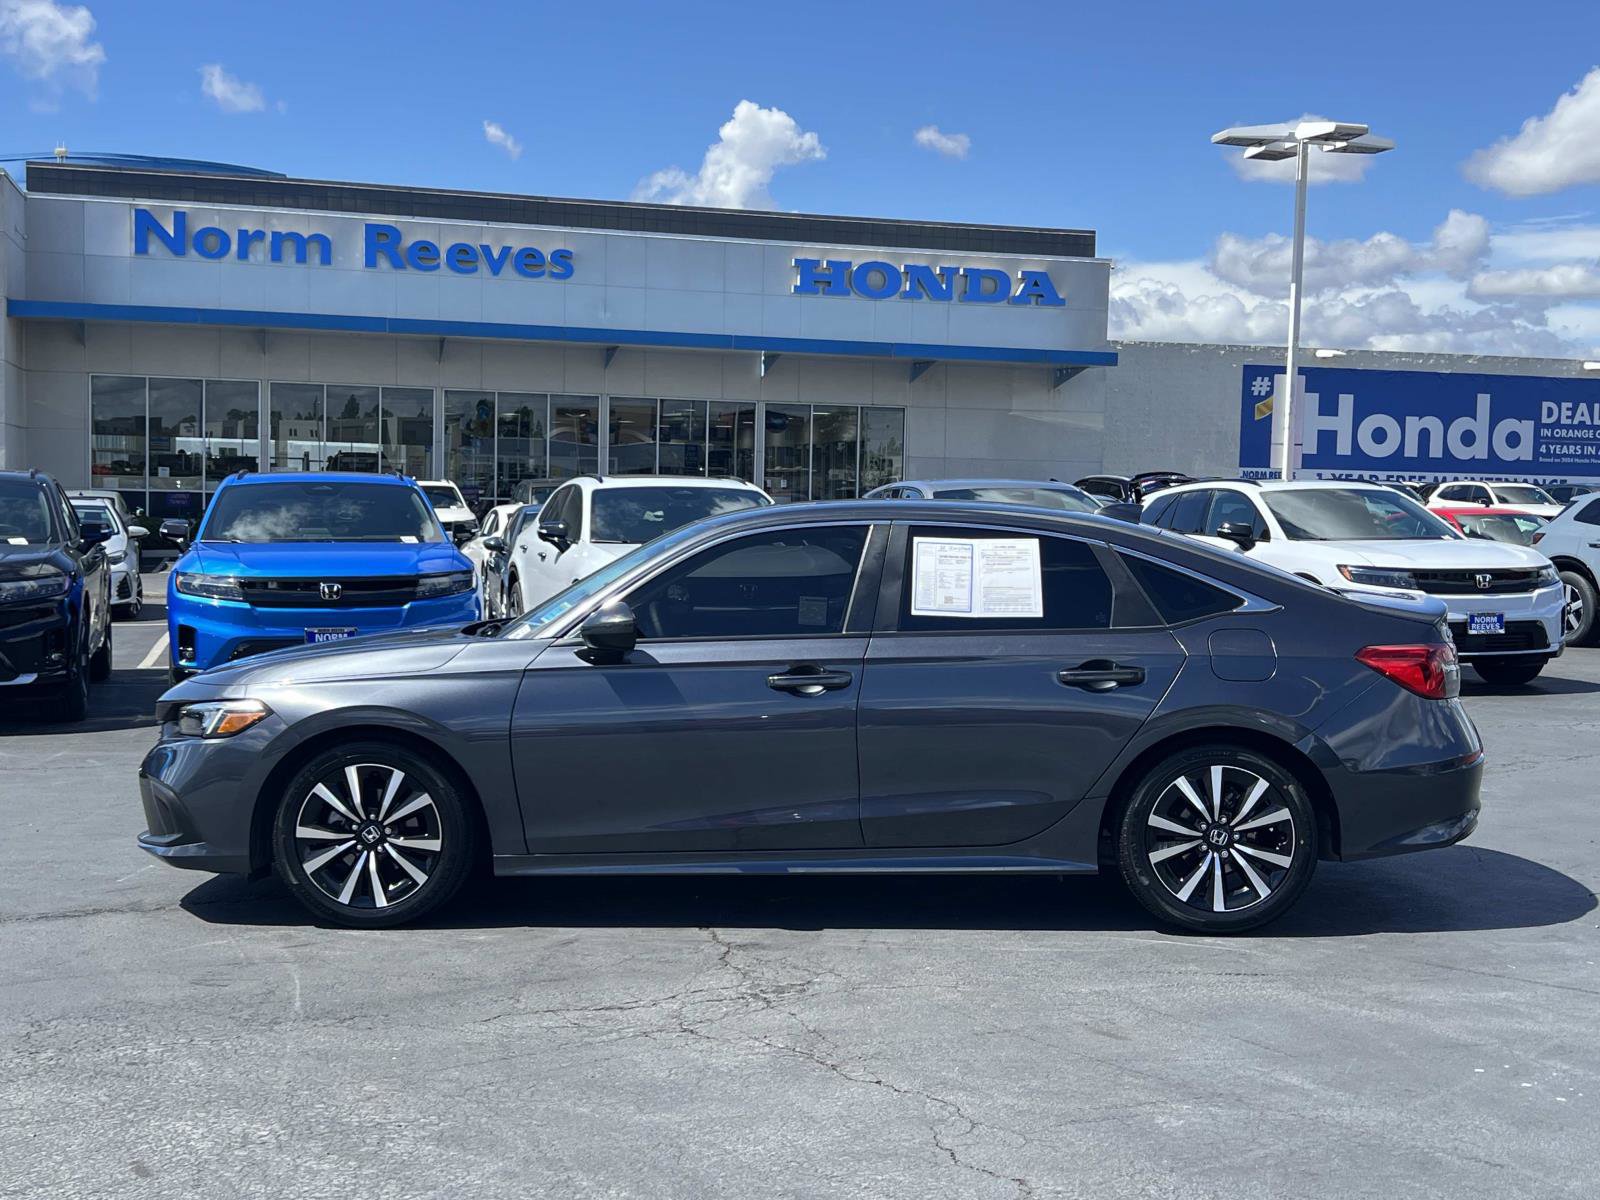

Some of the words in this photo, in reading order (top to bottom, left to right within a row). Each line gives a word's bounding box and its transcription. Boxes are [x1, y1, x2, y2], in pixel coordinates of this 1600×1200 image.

[134, 208, 332, 266] Norm
[364, 223, 574, 280] Reeves
[791, 258, 1066, 306] HONDA
[1541, 401, 1600, 425] DEAL
[1302, 393, 1534, 462] Honda
[1540, 428, 1552, 437] IN
[1553, 429, 1595, 439] ORANGE
[1540, 444, 1547, 454] 4
[1548, 444, 1582, 455] YEARS
[1583, 446, 1597, 455] IN
[1242, 470, 1267, 480] NORM
[1268, 471, 1297, 480] REES
[1471, 622, 1501, 630] REEVES
